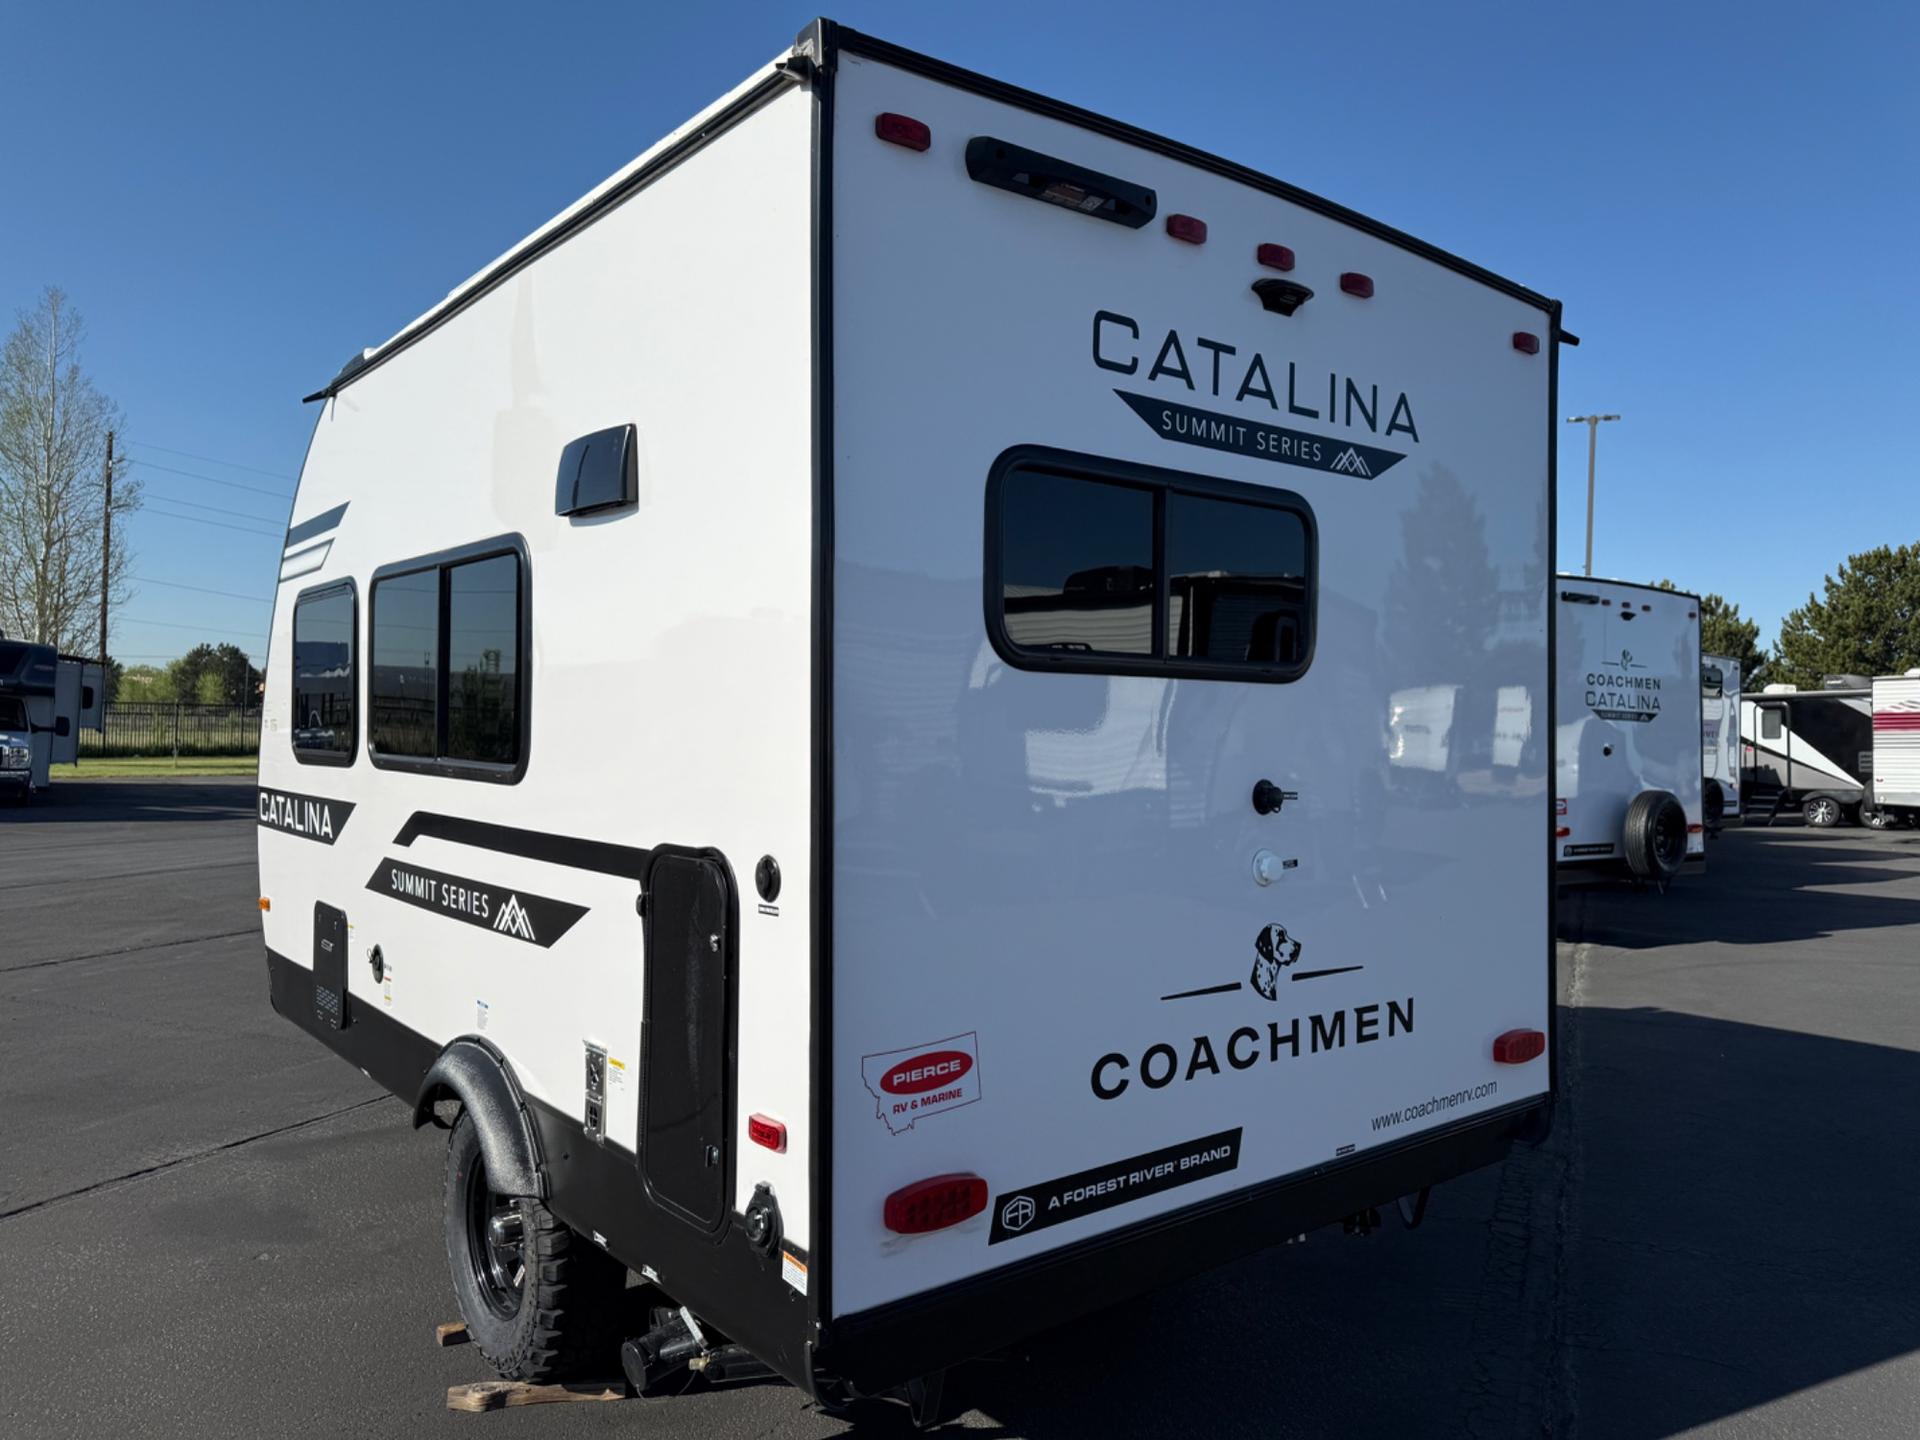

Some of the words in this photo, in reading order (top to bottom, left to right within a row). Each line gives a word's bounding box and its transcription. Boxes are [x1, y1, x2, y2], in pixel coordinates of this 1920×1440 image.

[1093, 310, 1420, 444] CATALINA
[1162, 410, 1248, 447] SUMMIT
[1256, 431, 1322, 462] SERIES
[1585, 690, 1662, 711] CATALINA
[1586, 673, 1662, 691] COACHMEN
[258, 791, 334, 840] CATALINA
[390, 868, 437, 903] SUMMIT
[441, 883, 490, 919] SERIES
[893, 1059, 962, 1087] PIERCE
[1091, 998, 1415, 1101] COACHMEN
[893, 1101, 909, 1115] RV
[910, 1099, 919, 1111] &
[920, 1087, 963, 1107] MARINE
[1371, 1080, 1498, 1132] www.coachmenrv.com
[1047, 1195, 1061, 1210] A
[1062, 1175, 1127, 1205] FOREST
[1179, 1145, 1232, 1171] BRAND
